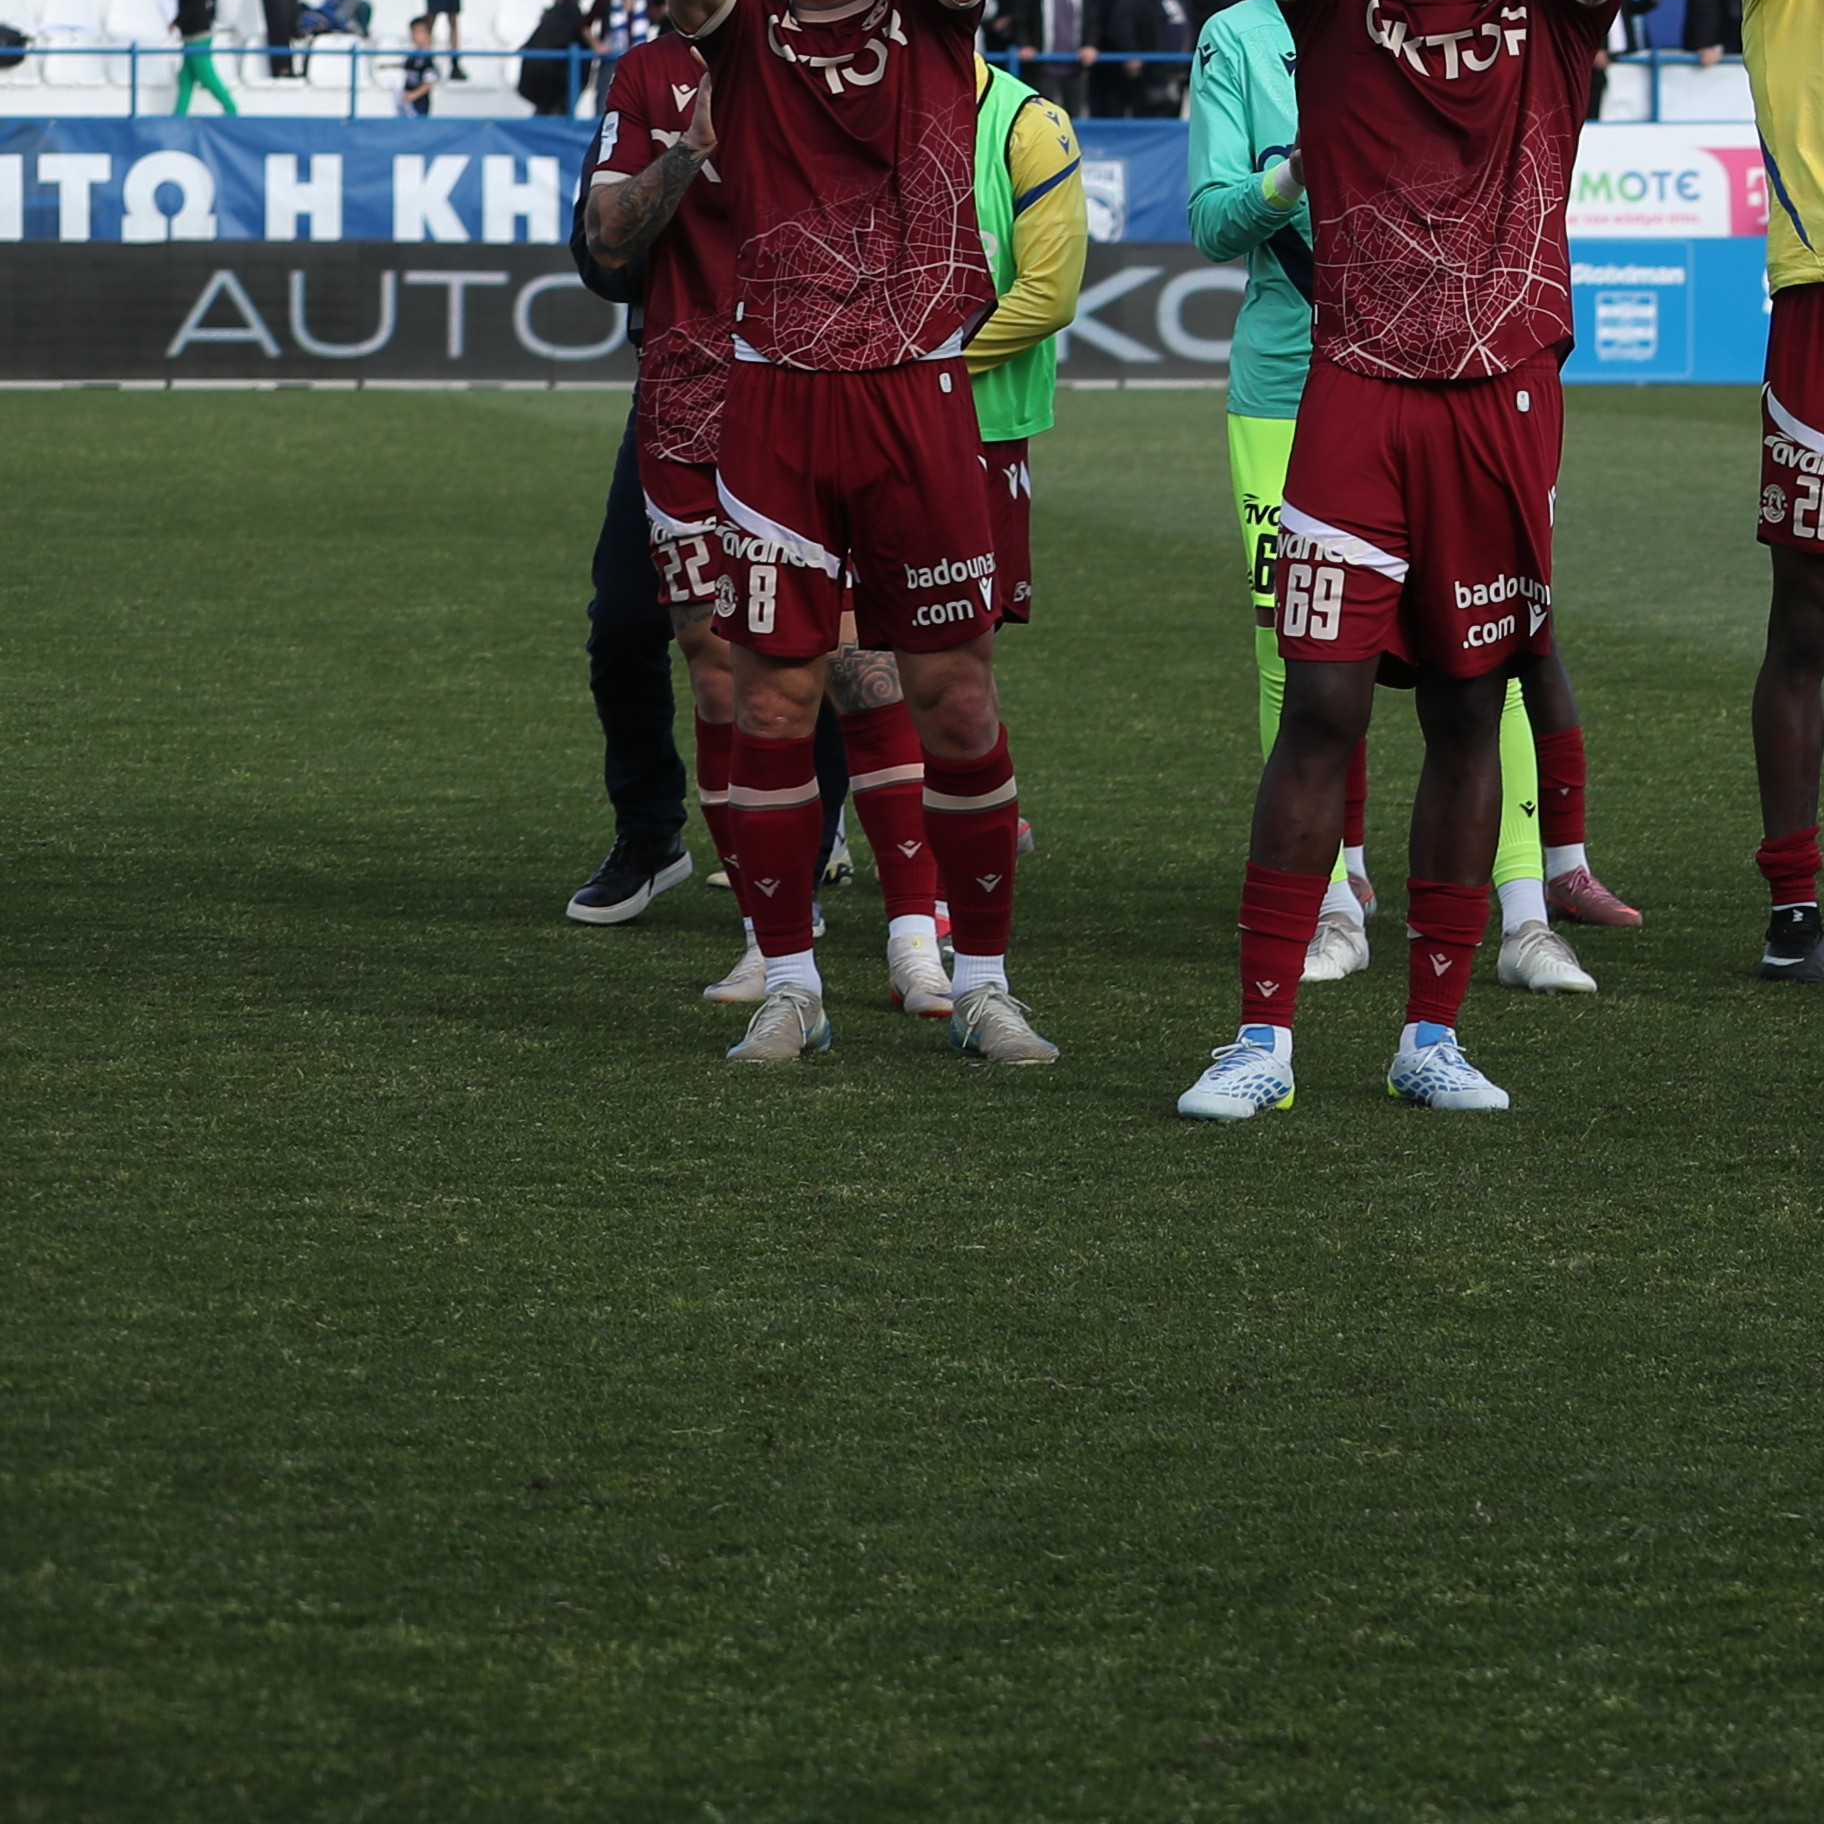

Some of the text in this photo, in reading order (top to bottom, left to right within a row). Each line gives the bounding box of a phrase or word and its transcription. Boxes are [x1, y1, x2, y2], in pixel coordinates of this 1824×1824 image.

[392, 153, 580, 243] ΚΗ
[1571, 170, 1701, 203] MOTE
[748, 564, 778, 634] 8
[911, 598, 975, 627] .com
[1282, 563, 1345, 641] 69
[1462, 613, 1515, 649] .com
